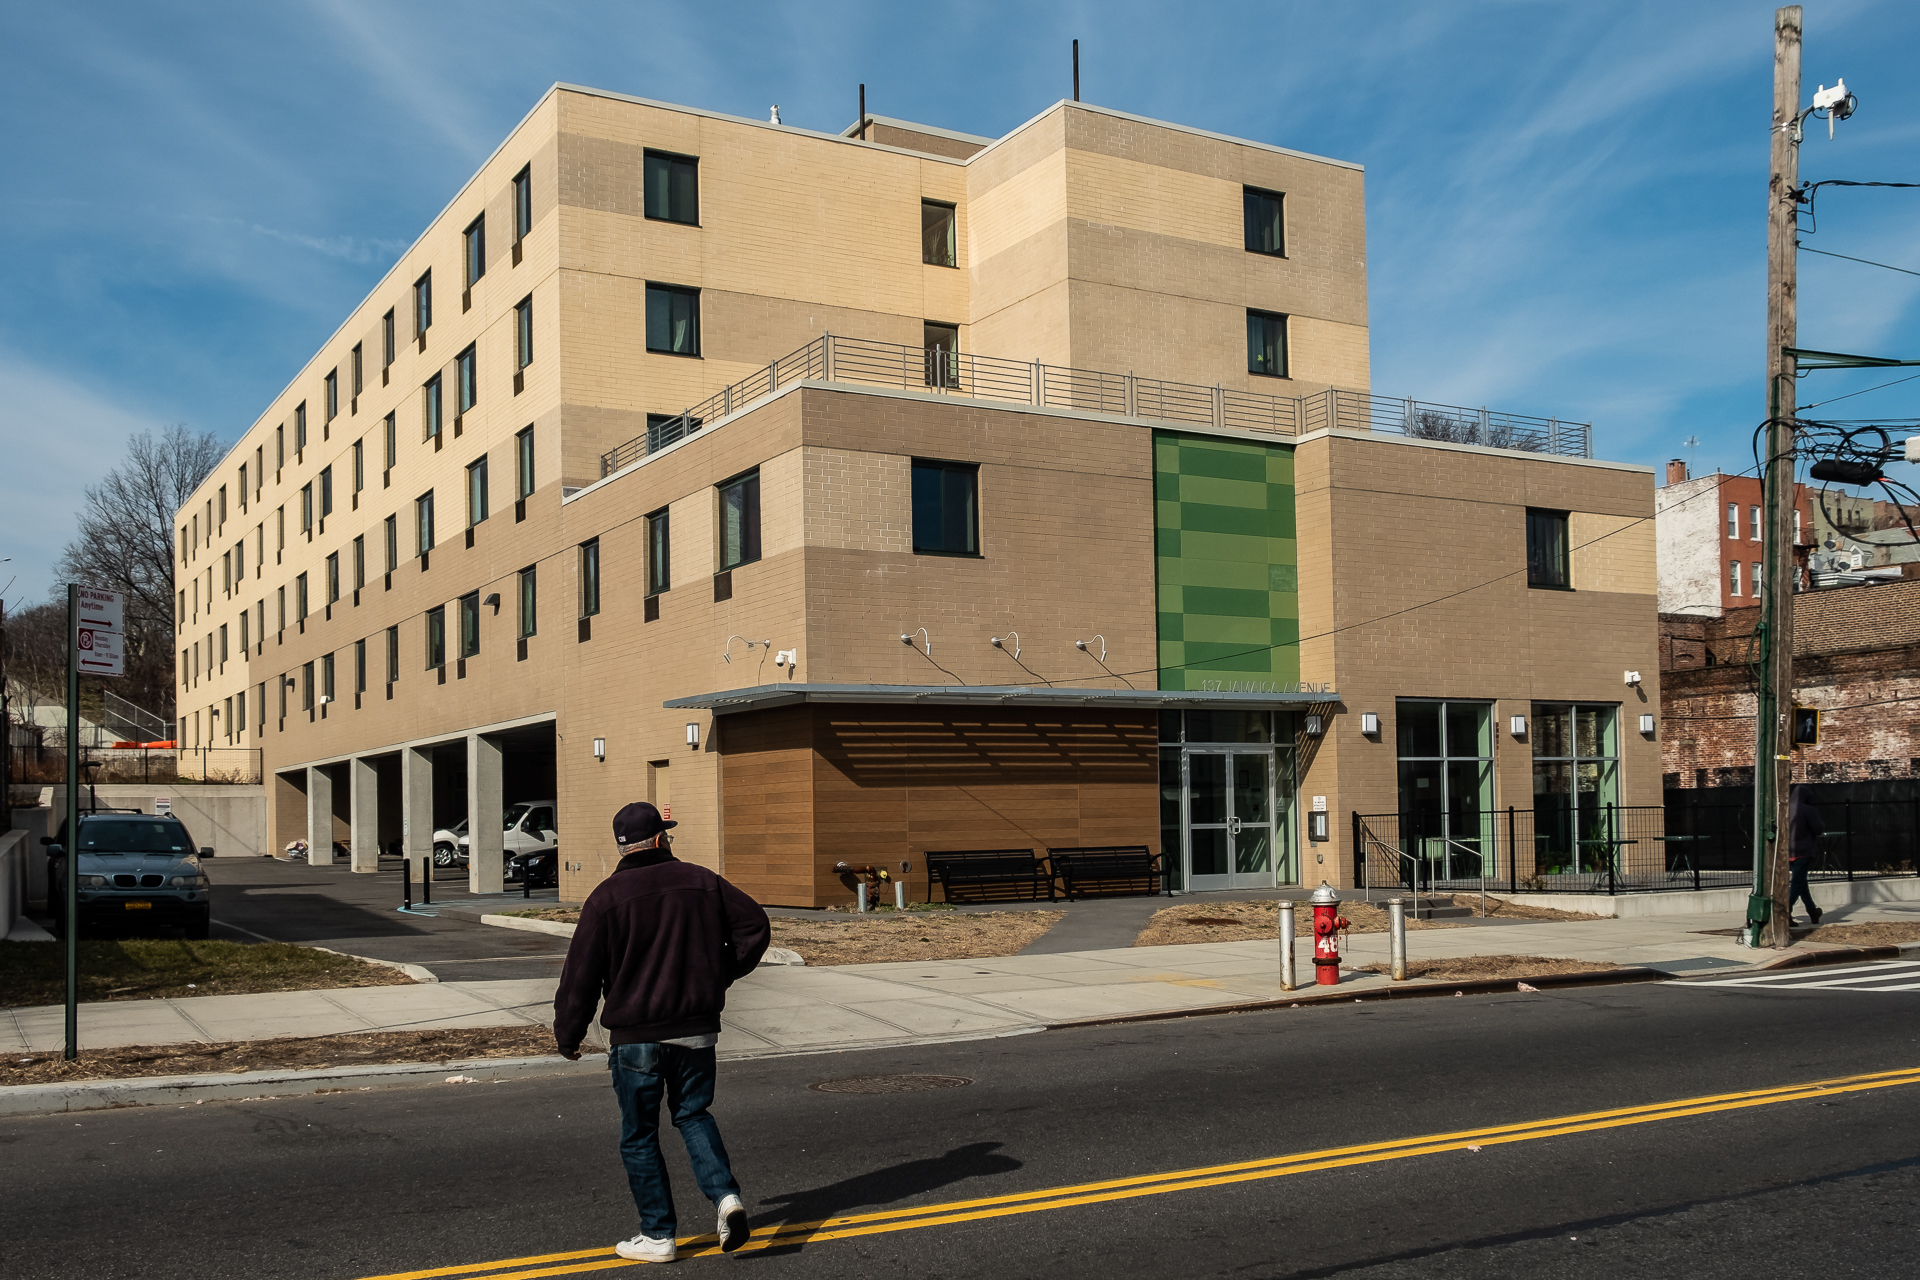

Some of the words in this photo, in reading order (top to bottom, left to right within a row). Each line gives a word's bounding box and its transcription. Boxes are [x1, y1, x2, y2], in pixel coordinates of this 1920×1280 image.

[80, 590, 89, 599] NO
[90, 591, 115, 603] PARKING
[80, 600, 104, 611] Anytime
[1201, 679, 1222, 692] 137
[1226, 680, 1279, 693] JAMAICA
[1283, 681, 1331, 693] AVENUE
[1317, 936, 1338, 953] 48
